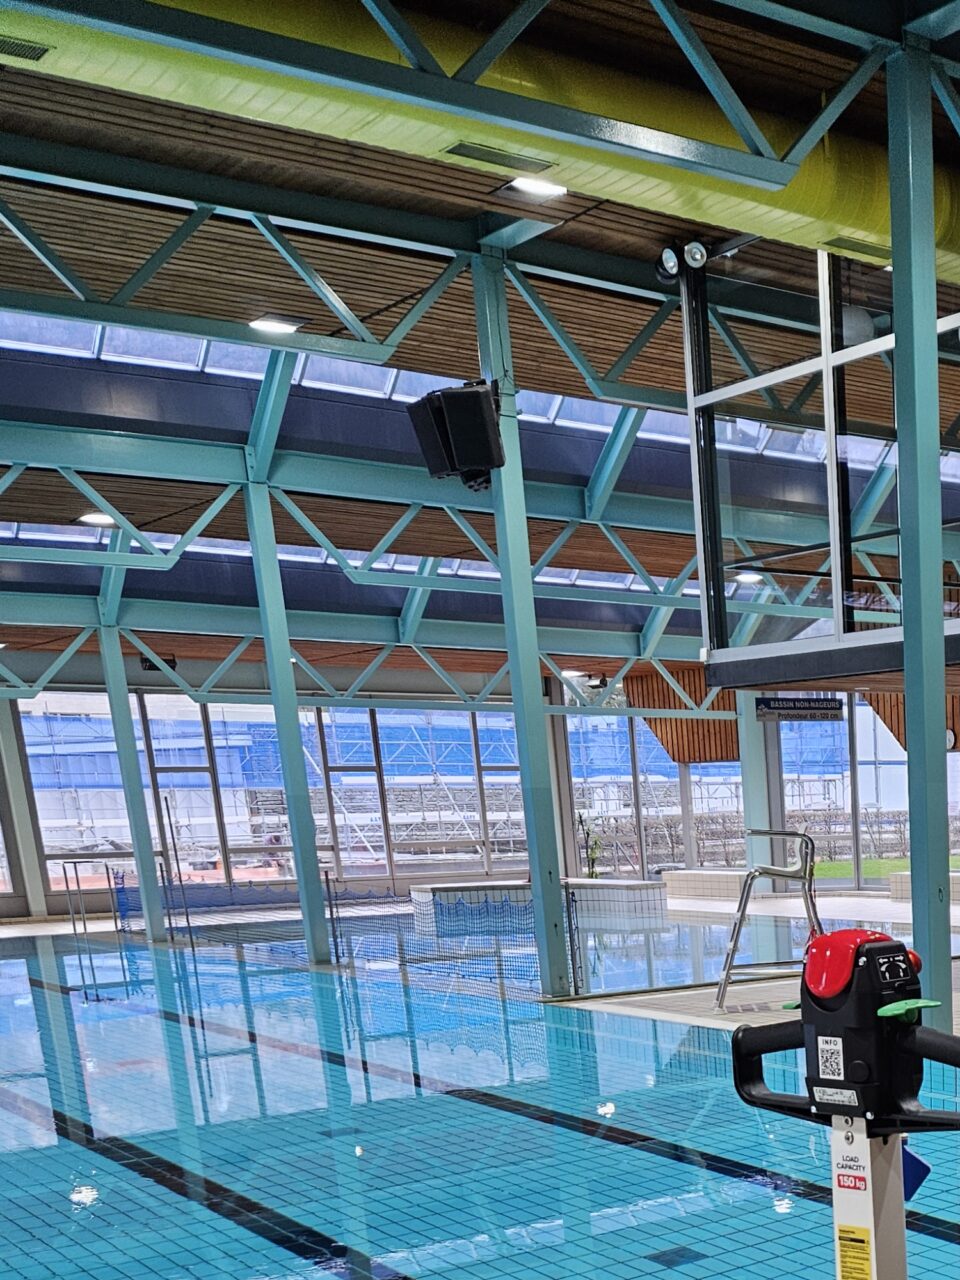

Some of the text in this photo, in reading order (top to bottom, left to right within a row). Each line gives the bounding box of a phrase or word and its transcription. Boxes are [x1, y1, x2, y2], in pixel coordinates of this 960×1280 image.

[795, 701, 840, 709] NON-NAGEURS
[777, 712, 808, 720] Profondeur
[842, 1155, 859, 1163] LOAD
[836, 1163, 866, 1172] CAPACITY
[838, 1175, 866, 1190] 150 kg
